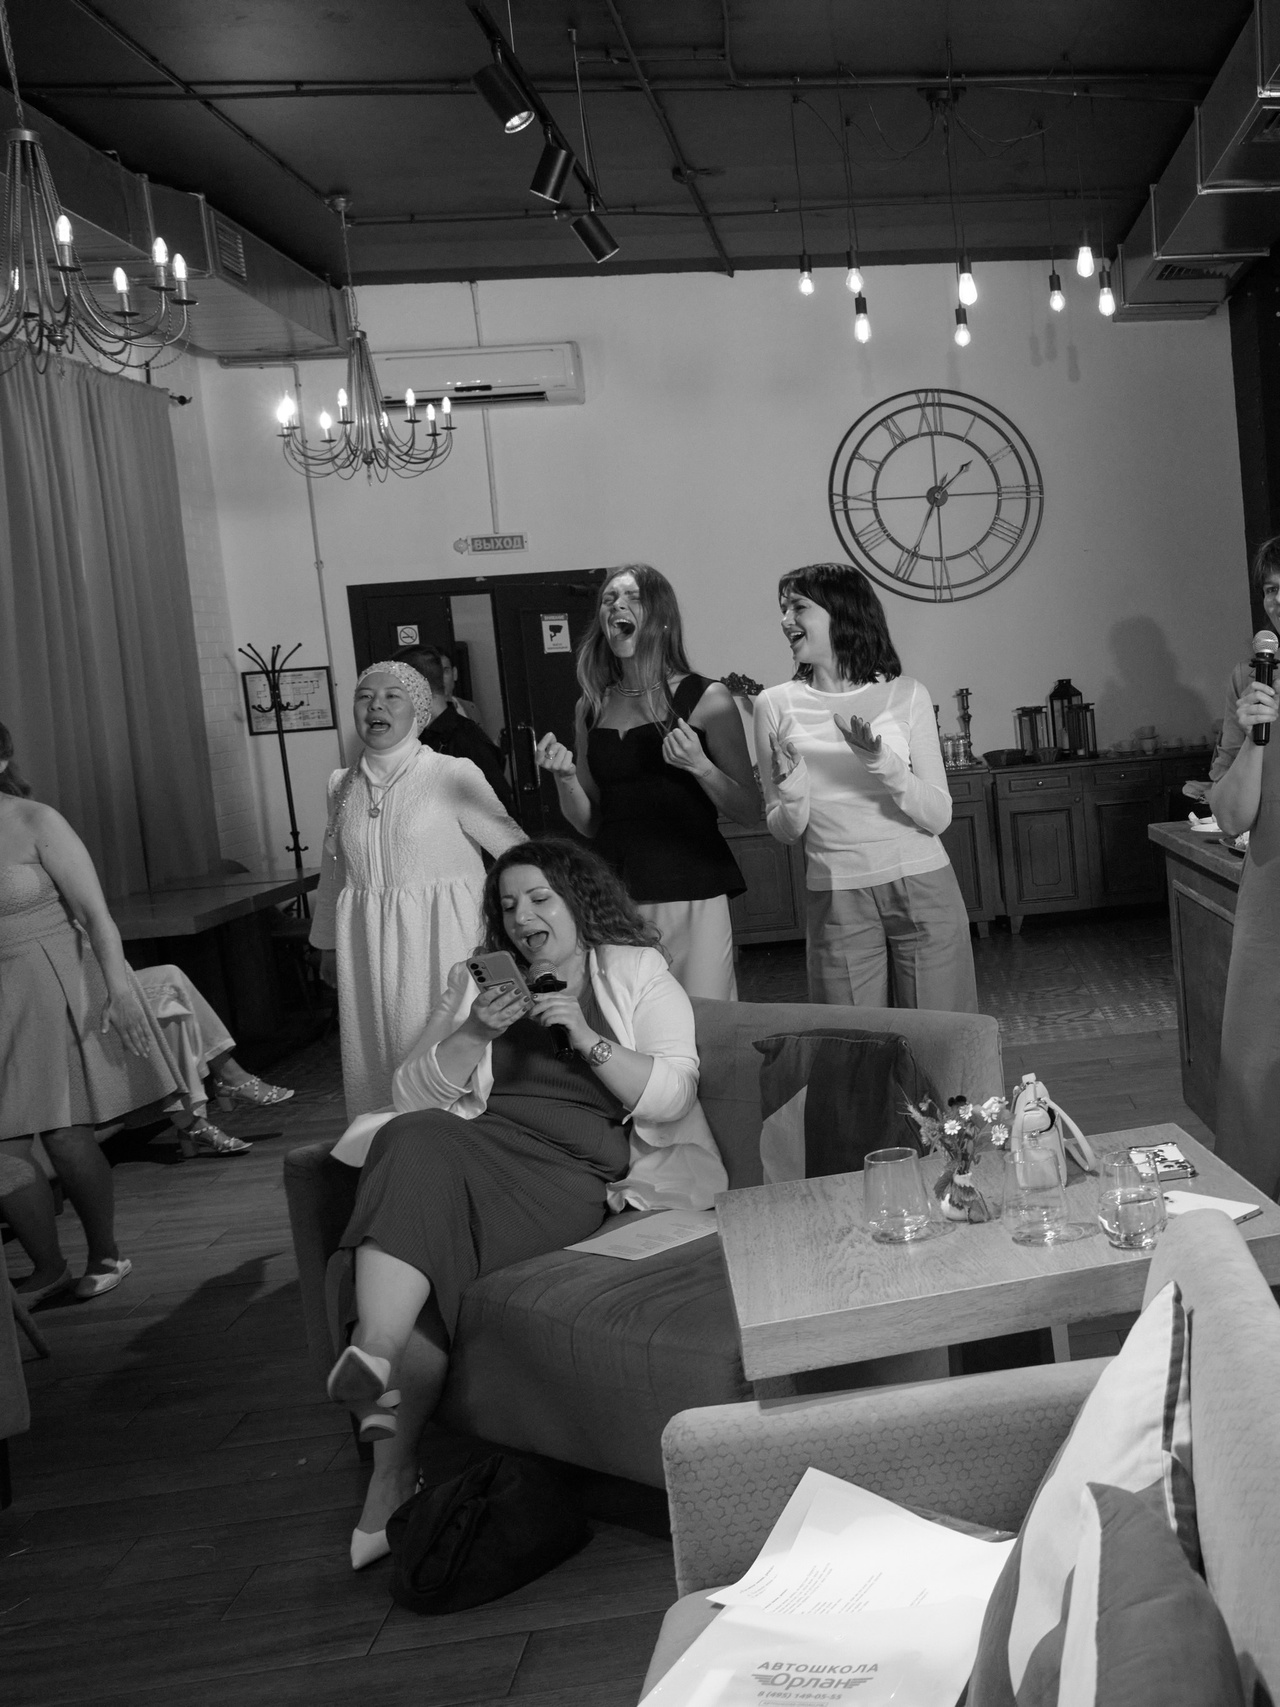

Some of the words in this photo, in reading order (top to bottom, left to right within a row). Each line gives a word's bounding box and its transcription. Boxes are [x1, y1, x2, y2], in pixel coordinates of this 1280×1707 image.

[474, 537, 523, 551] ВЫХОД
[757, 1662, 878, 1674] АВТОШКОЛА
[770, 1673, 853, 1691] Орлан
[765, 1691, 792, 1699] (495)
